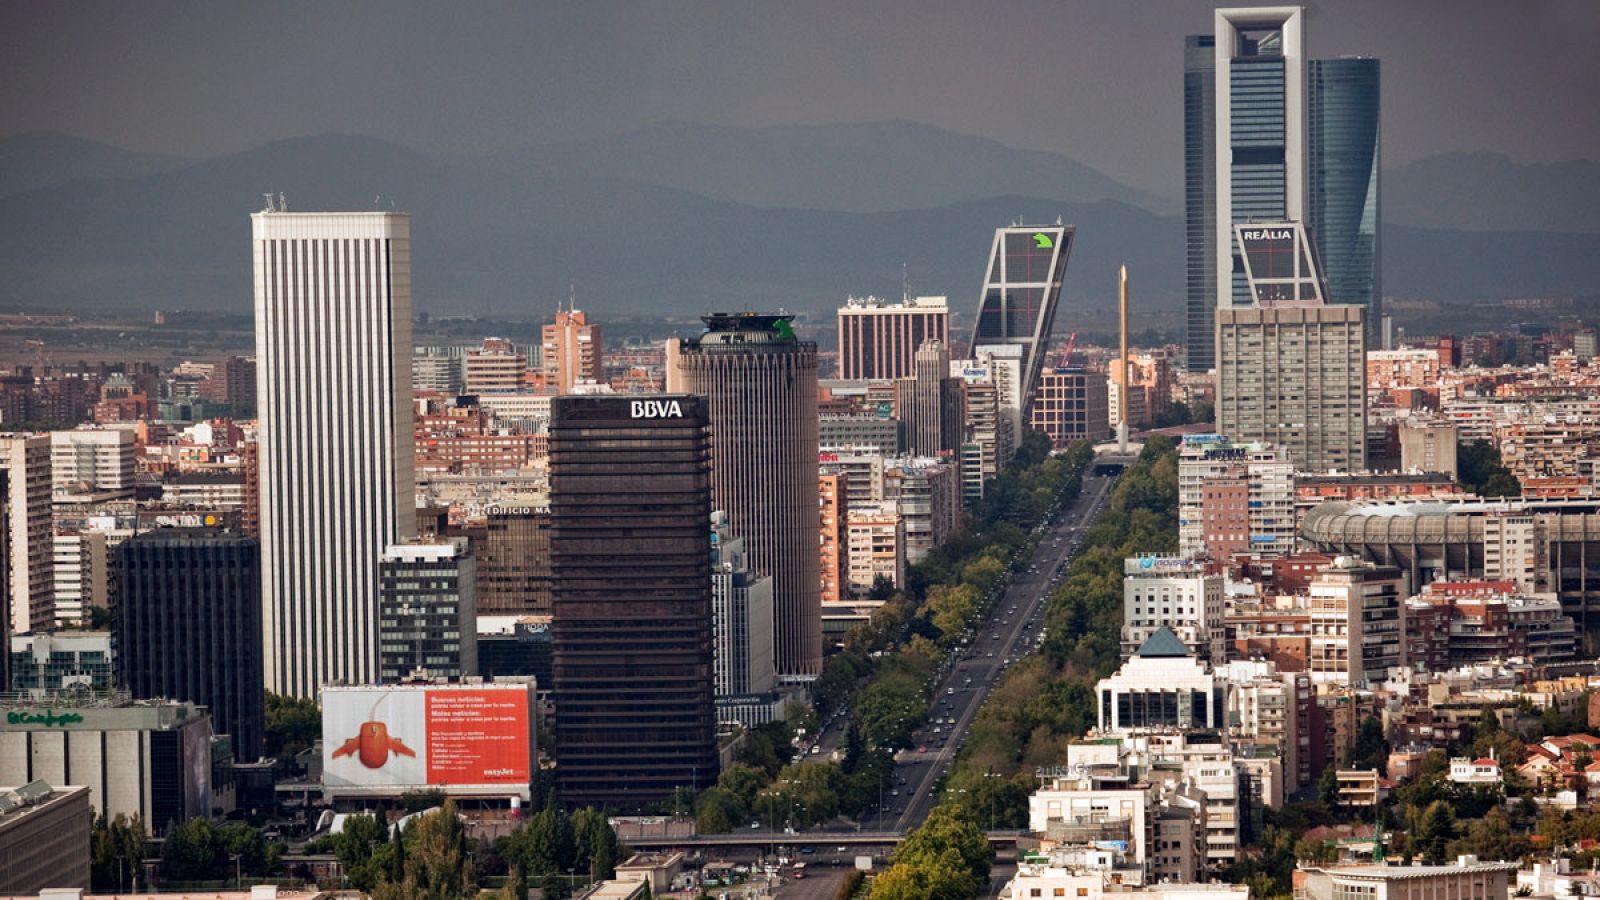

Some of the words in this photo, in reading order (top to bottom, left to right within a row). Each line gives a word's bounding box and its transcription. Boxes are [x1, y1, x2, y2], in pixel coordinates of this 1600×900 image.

[631, 400, 683, 418] BBVA
[535, 506, 551, 514] MA
[483, 768, 513, 777] easyJet
